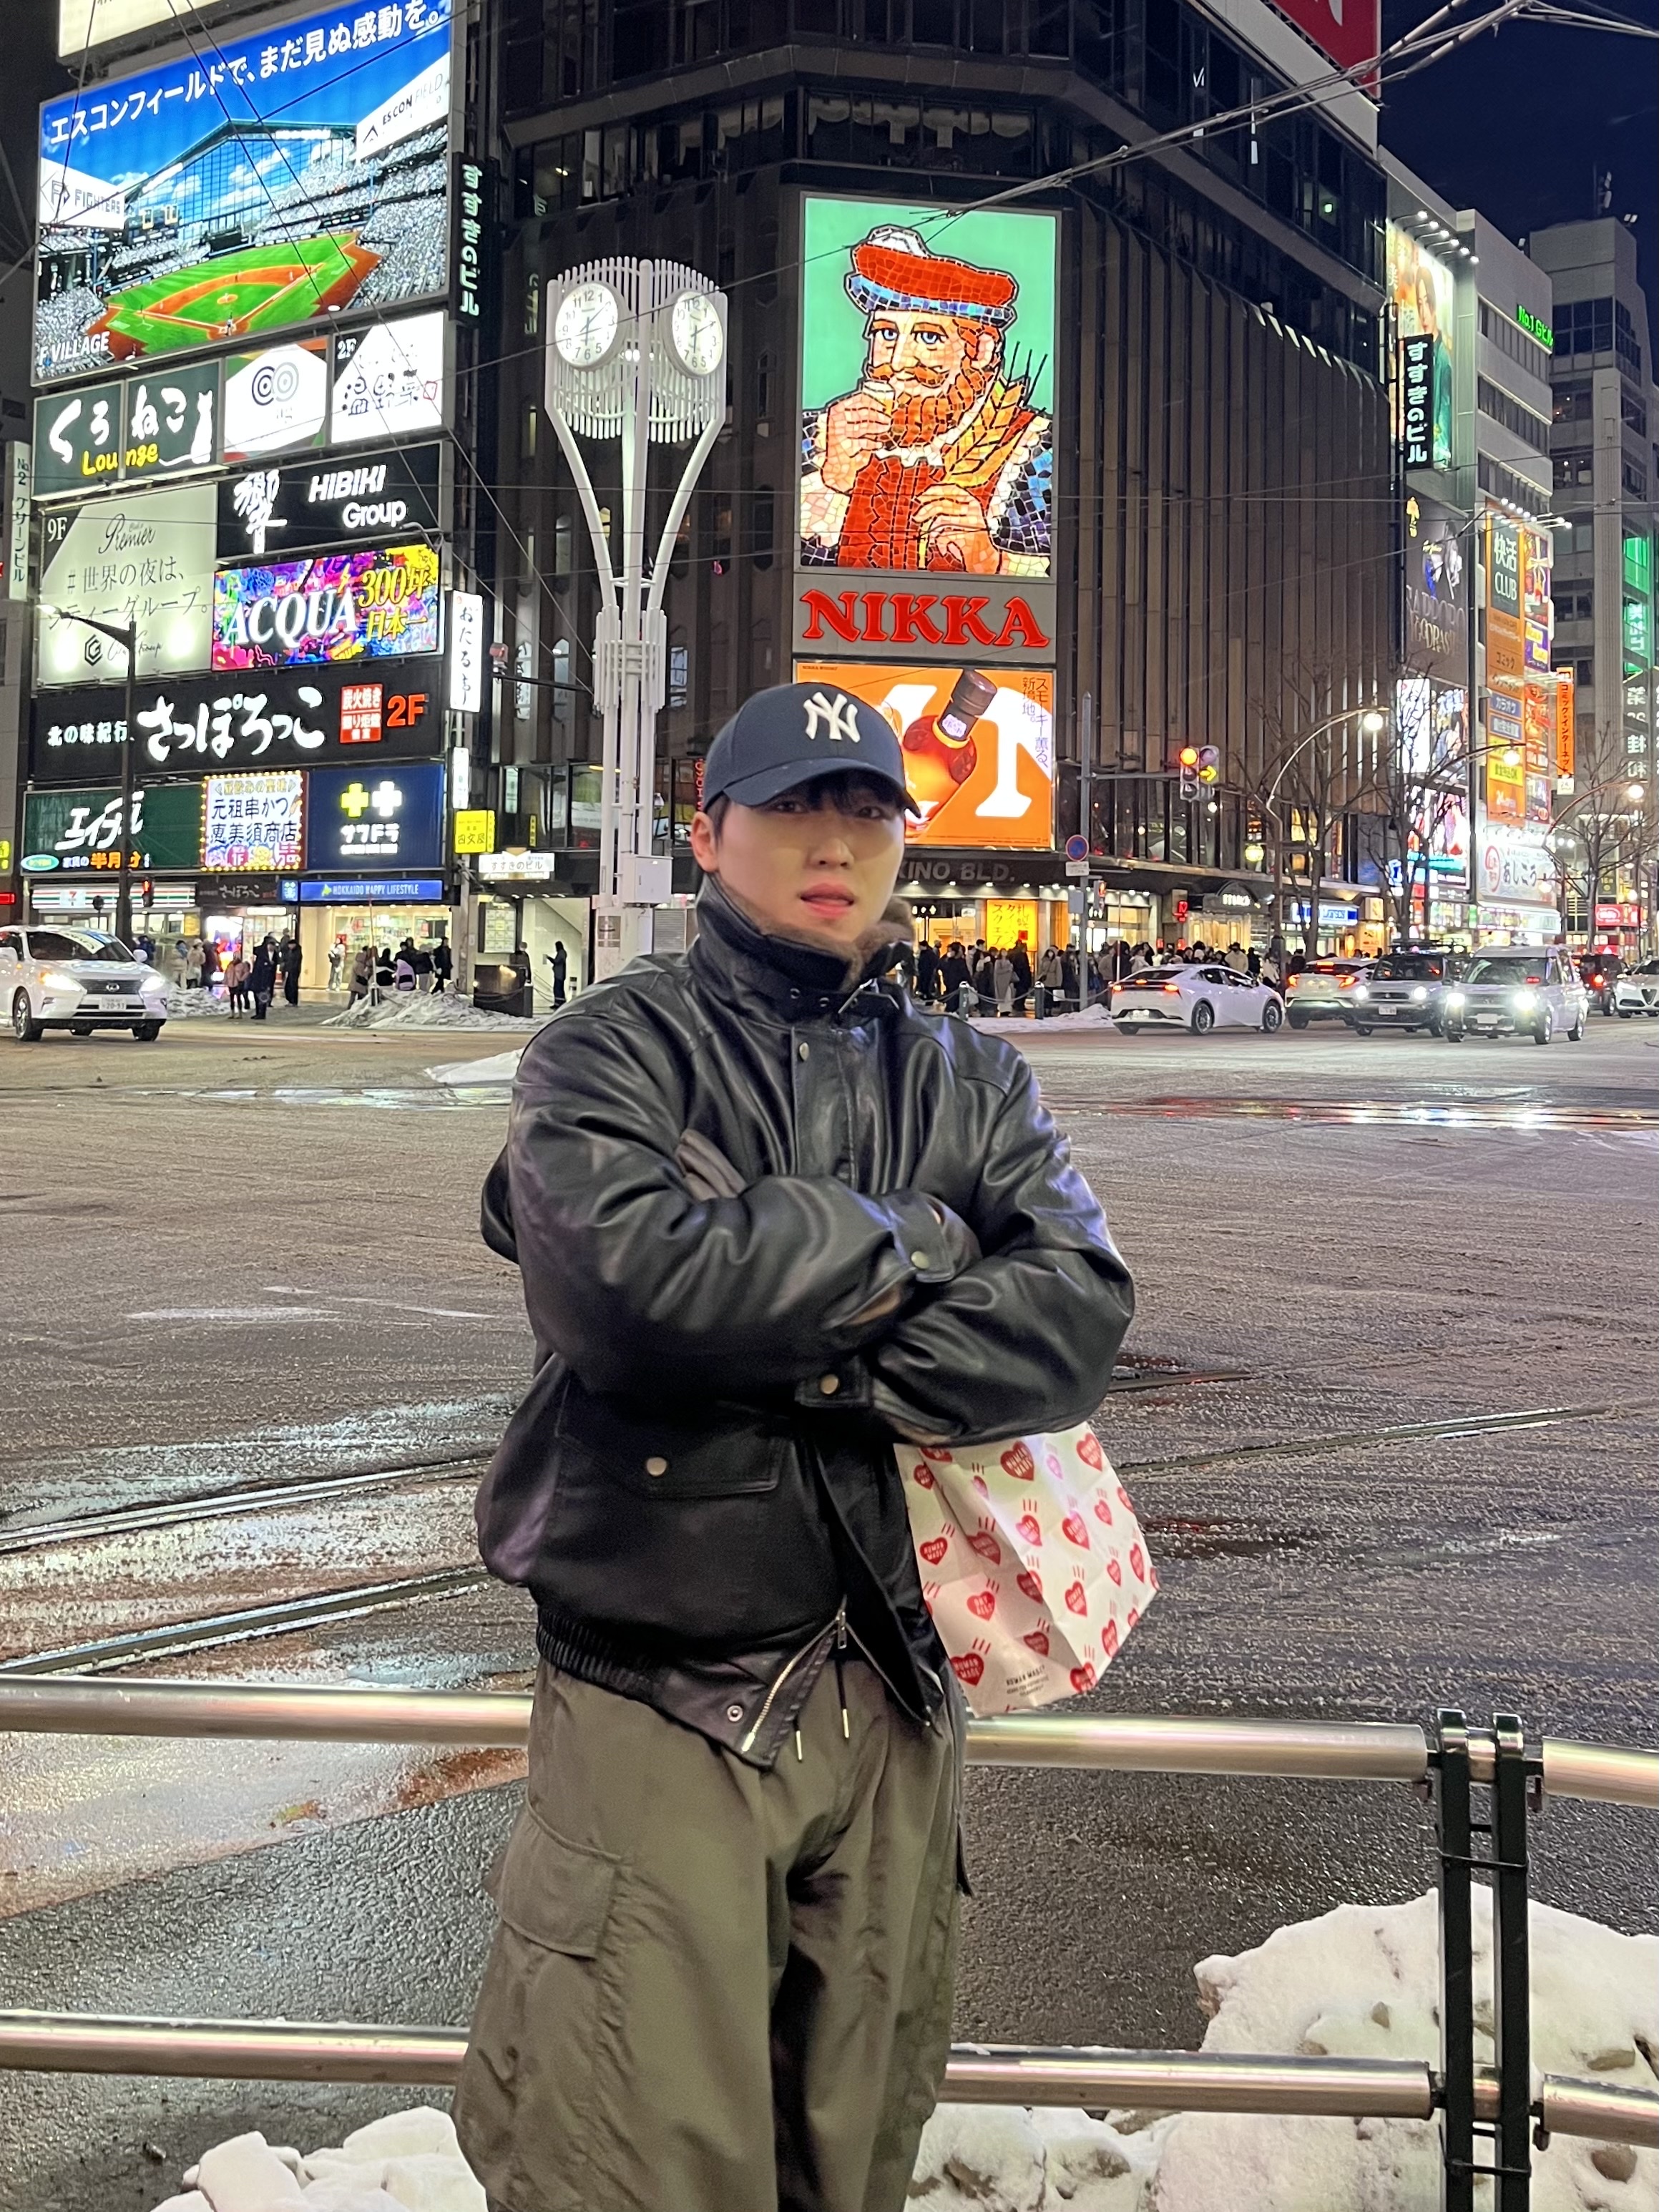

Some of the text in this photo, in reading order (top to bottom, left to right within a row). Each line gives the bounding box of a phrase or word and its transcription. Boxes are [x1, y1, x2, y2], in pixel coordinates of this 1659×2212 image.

[51, 0, 439, 145] エスコンフィールドで、まだ見ぬ感動を。
[383, 94, 413, 126] ESCON
[74, 188, 120, 215] FIGHTERS
[52, 331, 110, 358] VILLAGE
[338, 338, 357, 359] 2F
[1406, 341, 1429, 464] すすきのビル
[49, 384, 187, 463] くろねこ
[81, 443, 159, 476] Lounge
[308, 464, 387, 502] HIBIKI
[47, 517, 68, 542] 9F
[343, 500, 407, 528] Group
[1494, 532, 1517, 572] 快活
[358, 565, 431, 608] 300坪
[1494, 572, 1517, 601] CLUB
[222, 587, 356, 648] ACQUA
[367, 609, 429, 641] 日本一
[801, 589, 1050, 648] NIKKA
[1497, 652, 1515, 670] コミック
[137, 686, 325, 762] さっぽろっこ
[387, 694, 426, 727] 2F
[803, 691, 861, 743] NY
[212, 797, 288, 821] 元祖串かつ
[210, 821, 297, 844] 恵美須商店
[961, 863, 1015, 881] BLD.
[333, 884, 419, 895] HOKKAIDO HAPPY LIFESTYLE
